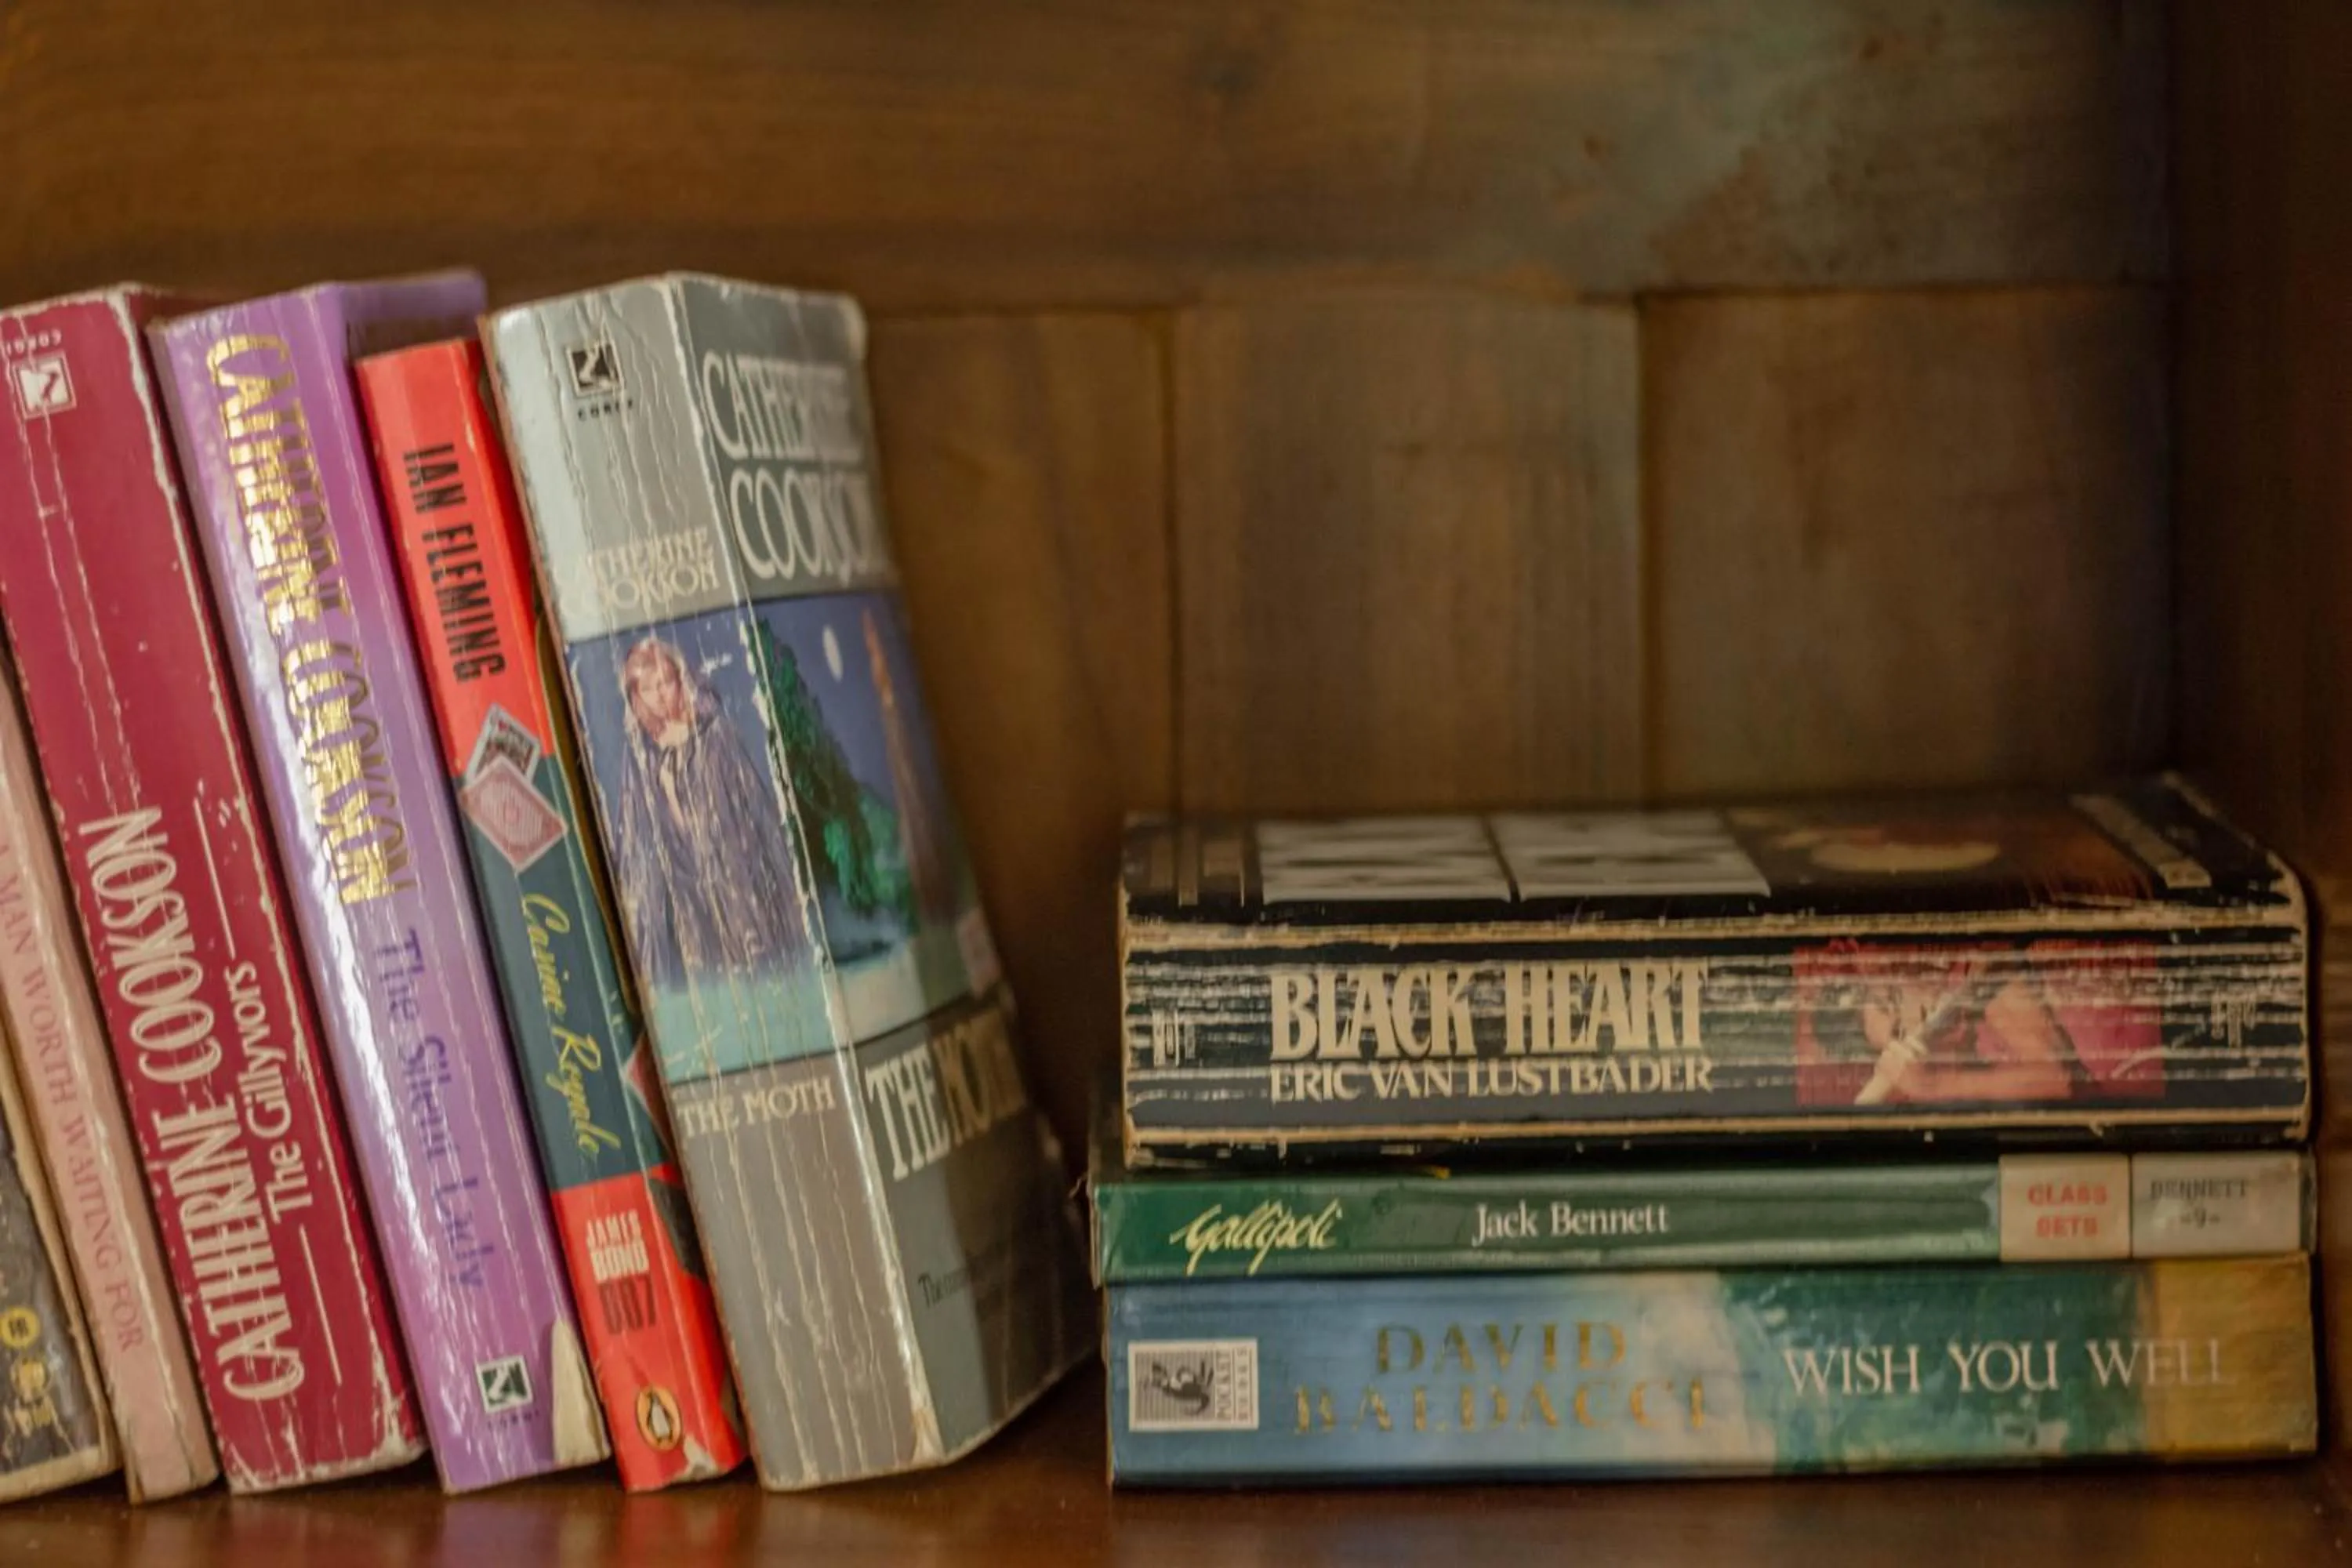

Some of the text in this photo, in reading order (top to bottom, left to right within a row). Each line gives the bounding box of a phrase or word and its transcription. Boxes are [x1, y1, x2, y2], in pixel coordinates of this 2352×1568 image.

[404, 443, 506, 684] IAN FLEMING
[282, 638, 419, 904] COOKSON
[374, 927, 424, 1019] The
[1270, 964, 1477, 1061] BLACK
[1504, 960, 1708, 1056] HEART
[79, 806, 304, 1401] CATHERINE COOKSON
[224, 960, 314, 1224] The Gillyvors
[546, 1025, 621, 1154] Royale
[676, 1076, 836, 1137] THE MOTH
[865, 1044, 951, 1182] THE
[931, 1008, 1026, 1149] MO
[1270, 1054, 1713, 1105] ERIC VAN LUSTBADER
[24, 966, 77, 1105] WORTH
[62, 1117, 122, 1269] WAITING
[105, 1278, 143, 1352] FOR
[2027, 1182, 2107, 1206] CLASS
[1171, 1200, 1341, 1276] Gallipoli
[1472, 1200, 1670, 1247] Jack Bennett
[2036, 1214, 2098, 1238] SETS
[599, 1274, 656, 1334] 007
[1377, 1320, 1626, 1374] DAVID
[1781, 1338, 2237, 1396] WISH YOU WELL
[1294, 1375, 1706, 1435] BALDACCI
